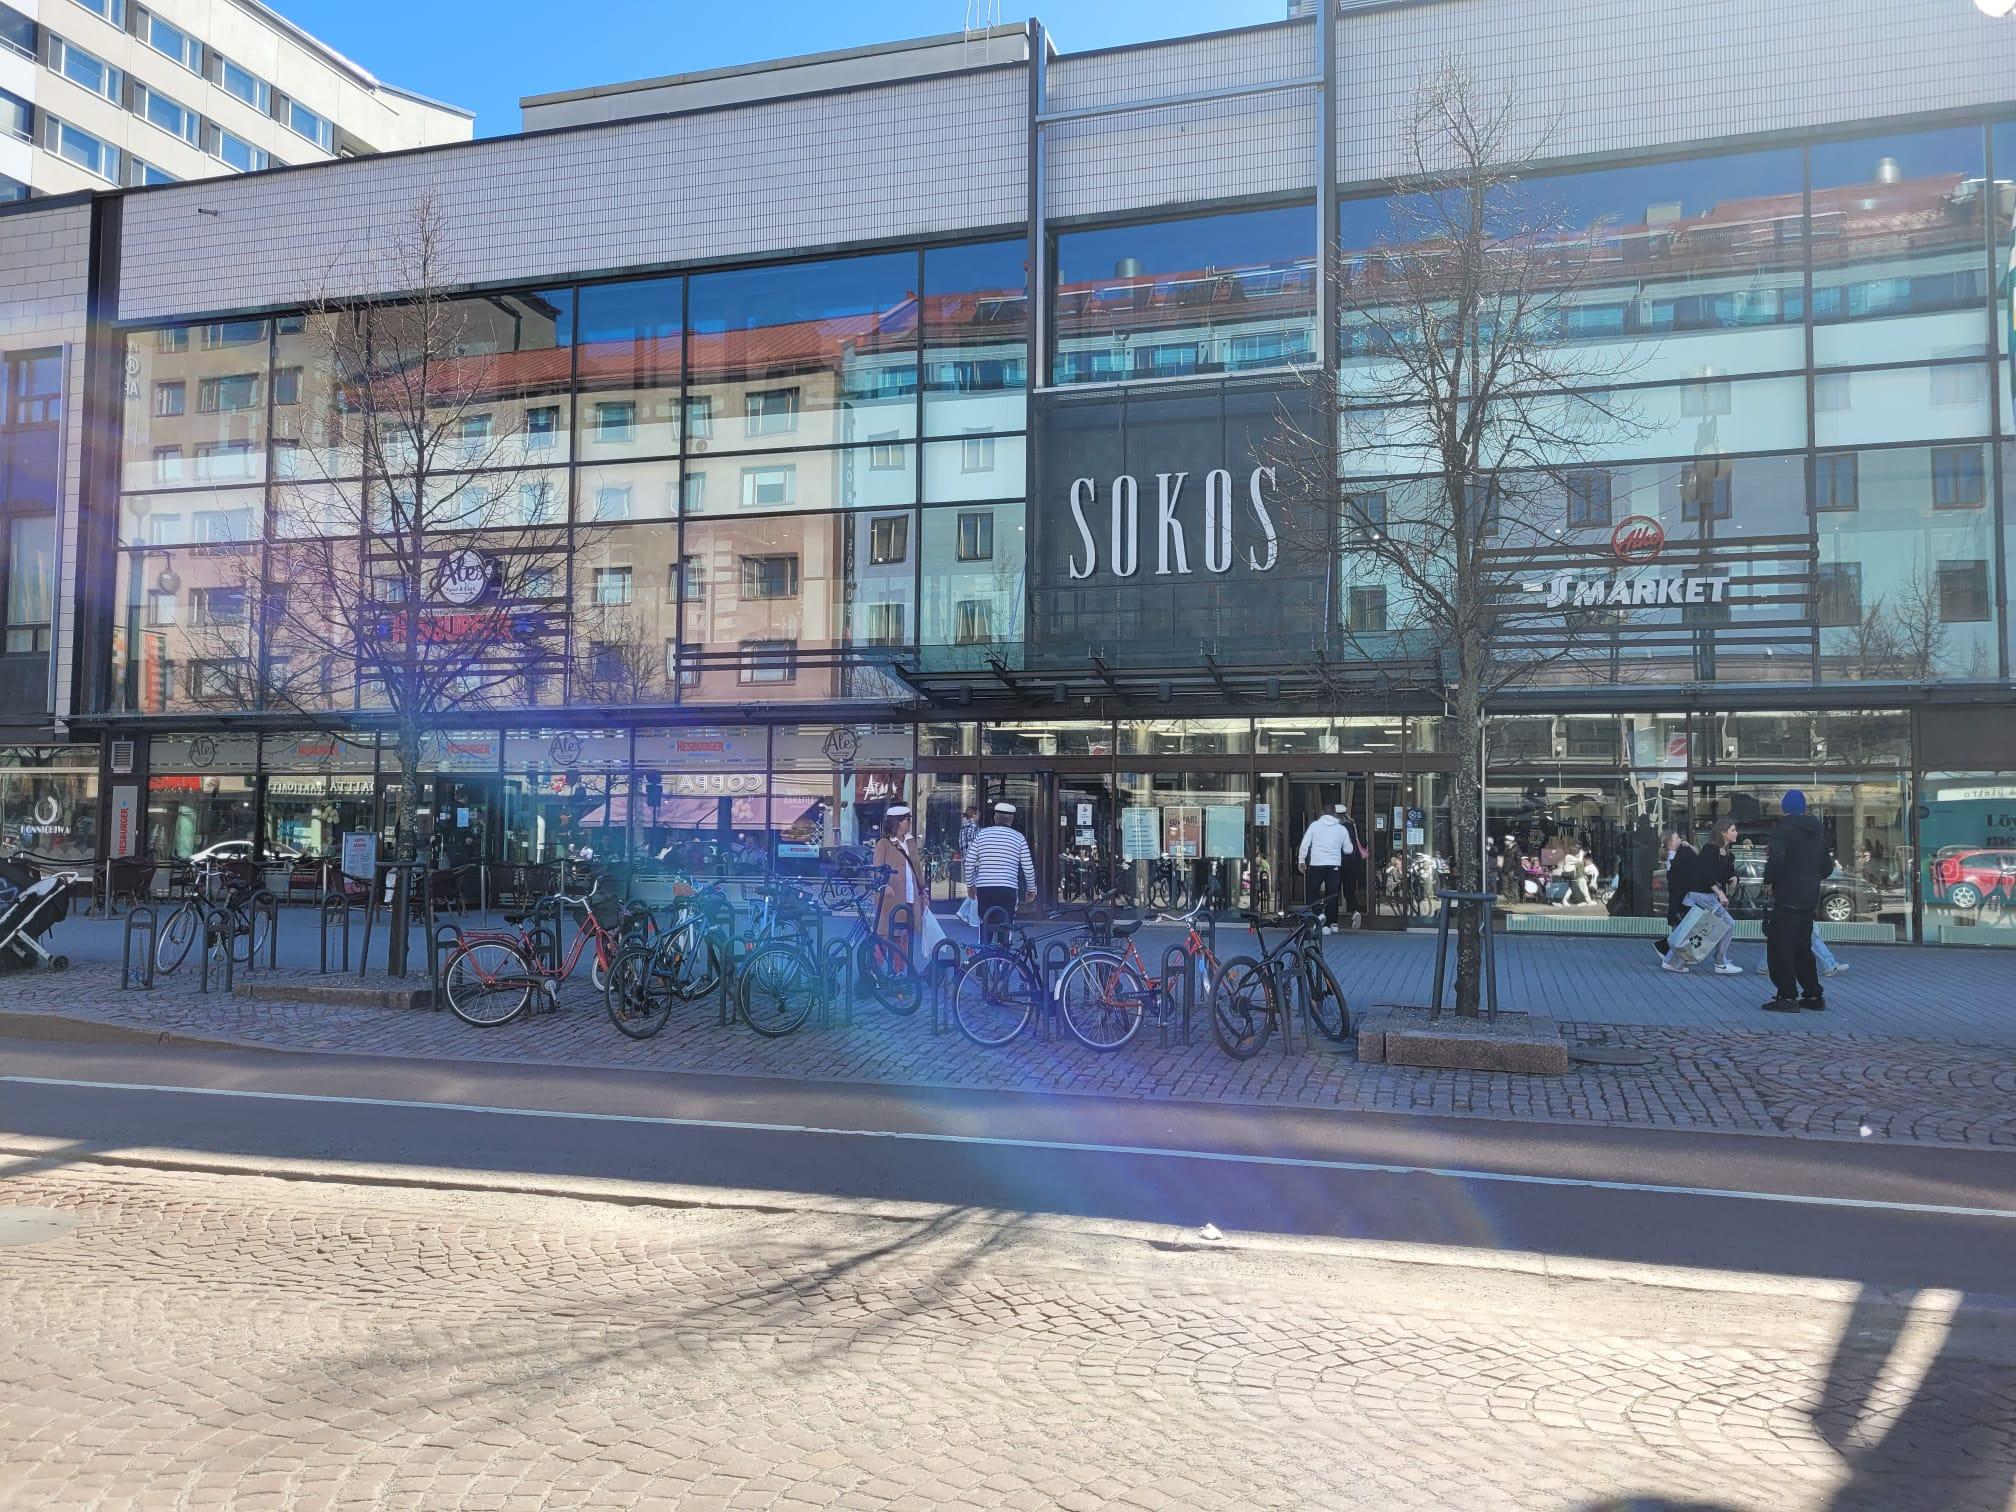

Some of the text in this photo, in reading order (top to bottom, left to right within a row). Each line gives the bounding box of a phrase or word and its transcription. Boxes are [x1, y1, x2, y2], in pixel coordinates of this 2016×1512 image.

[1069, 467, 1278, 579] SOKOS
[1614, 527, 1662, 550] Alko
[548, 735, 584, 755] Alex
[676, 740, 725, 753] HESBURGER
[822, 731, 862, 753] Alex
[118, 807, 129, 857] HESBURGER
